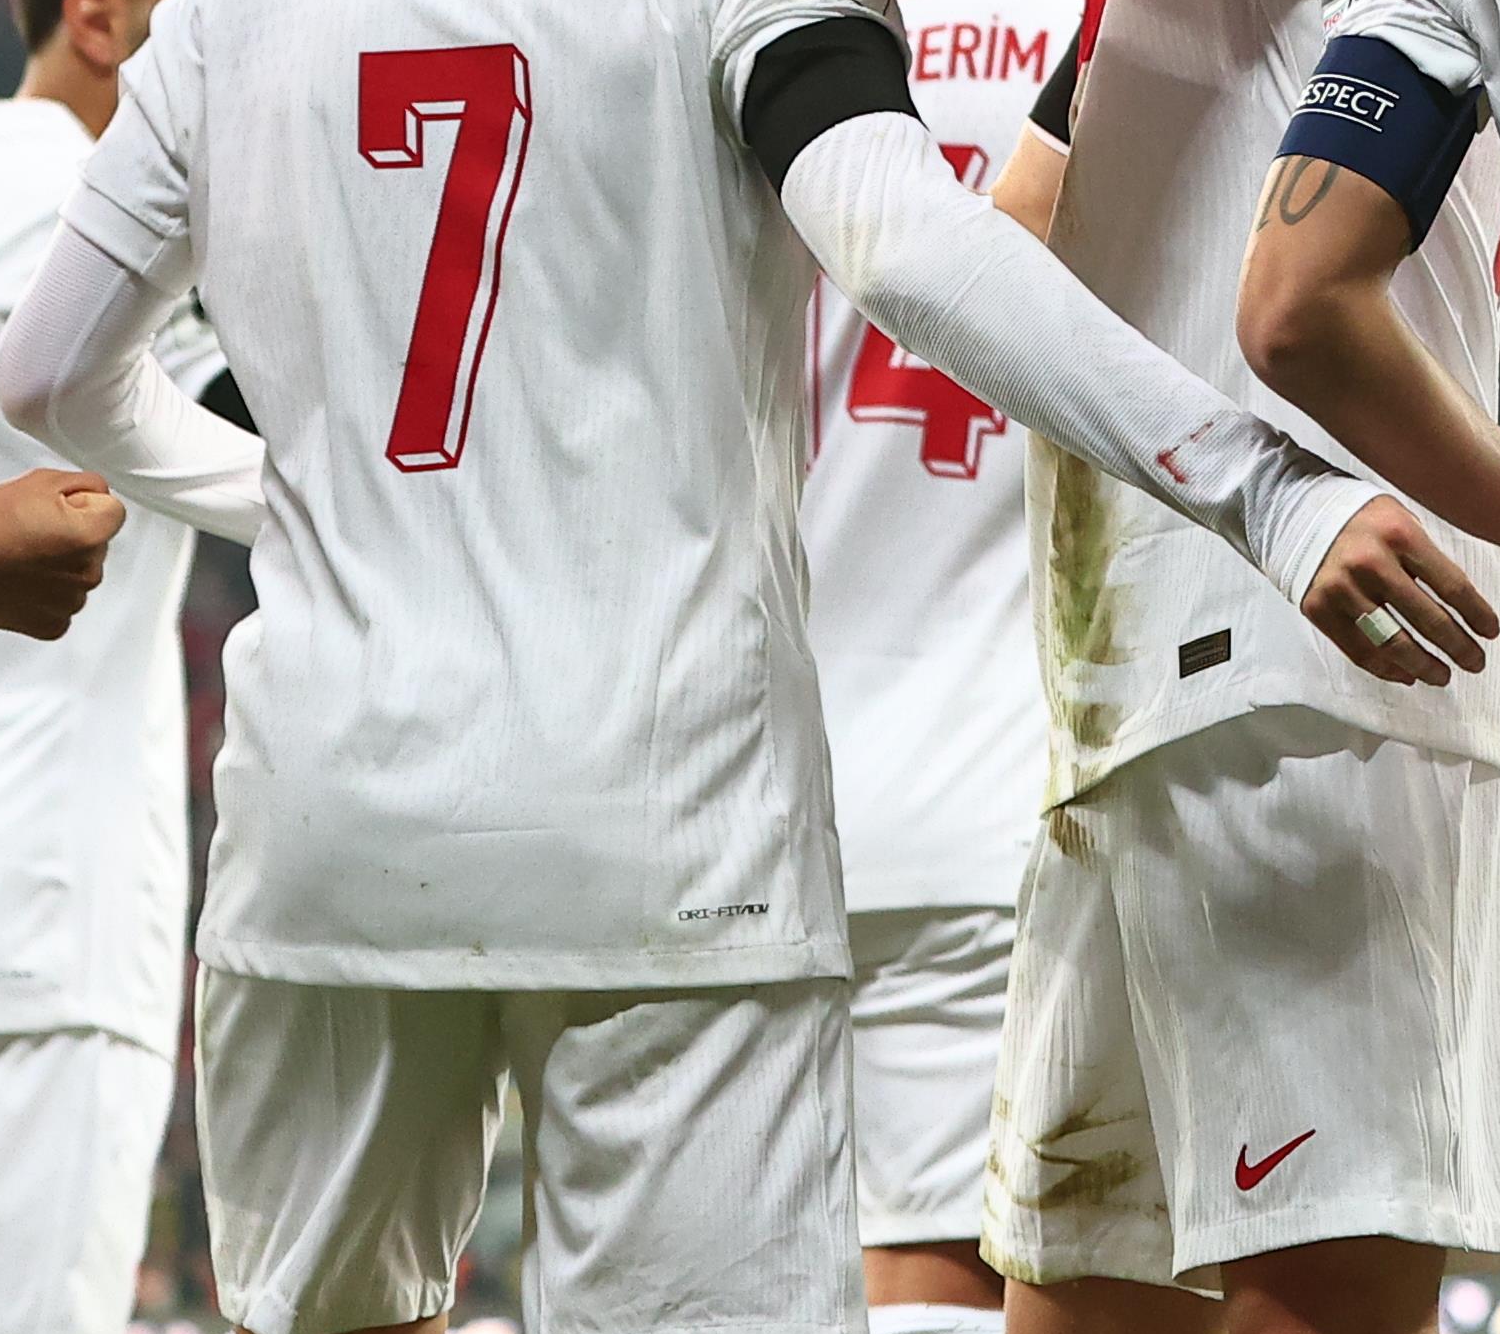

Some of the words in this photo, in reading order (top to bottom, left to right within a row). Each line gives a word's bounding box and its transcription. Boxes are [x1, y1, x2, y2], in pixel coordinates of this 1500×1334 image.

[908, 14, 1051, 84] ERİM
[1298, 81, 1395, 121] ESPECT
[358, 43, 531, 473] 7
[806, 143, 1008, 480] 4
